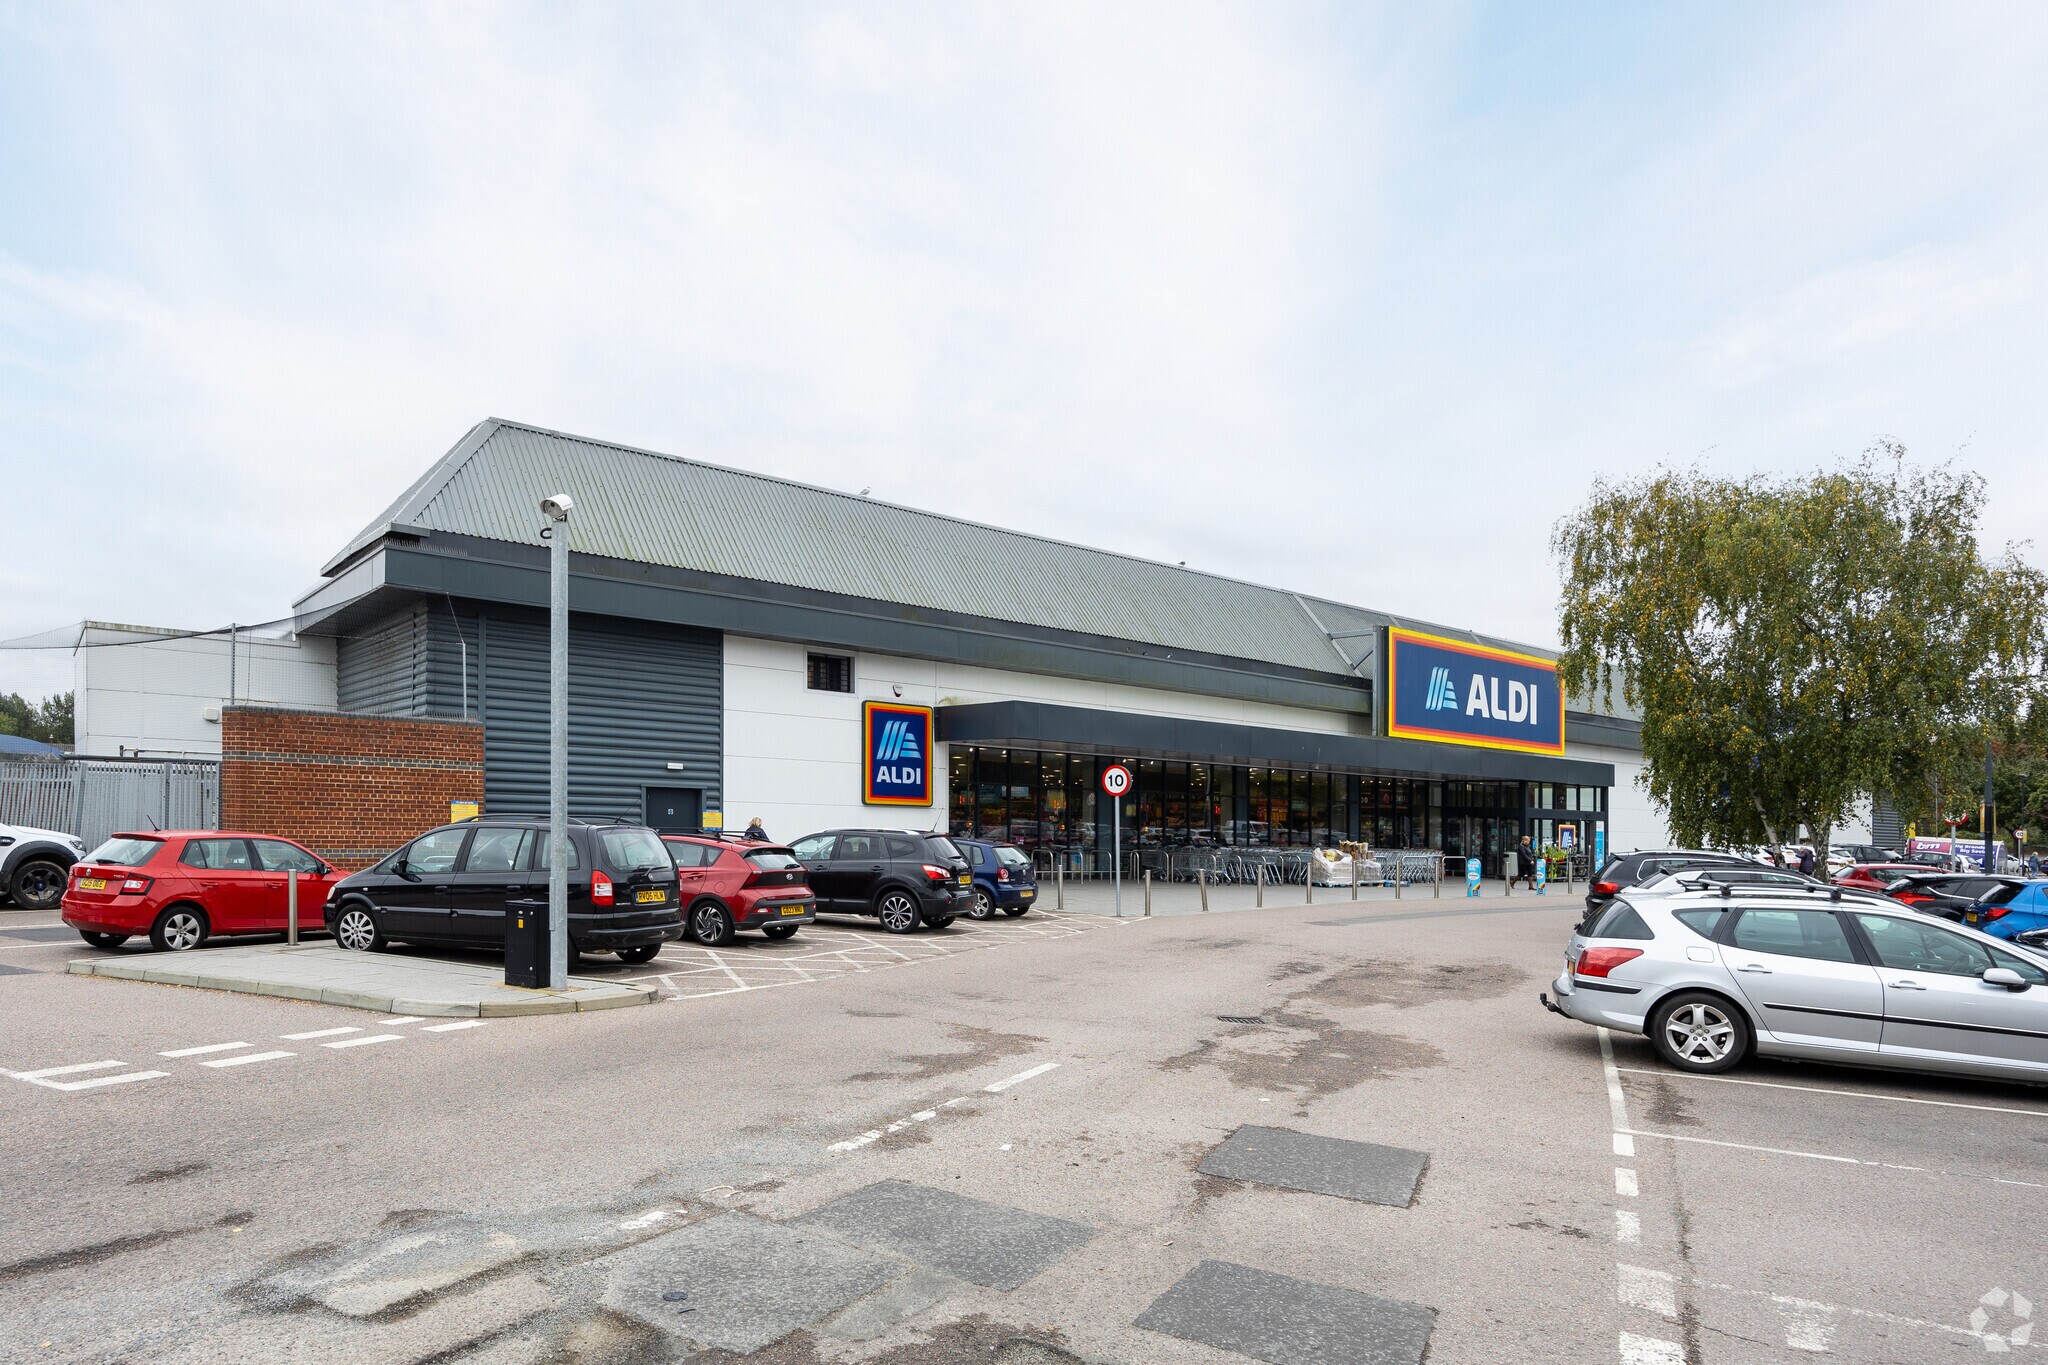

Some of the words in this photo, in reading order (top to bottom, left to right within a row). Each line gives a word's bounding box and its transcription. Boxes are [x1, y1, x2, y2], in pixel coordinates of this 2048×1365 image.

[1465, 673, 1538, 725] ALDI
[876, 765, 921, 785] ALDI
[1108, 774, 1124, 787] 10
